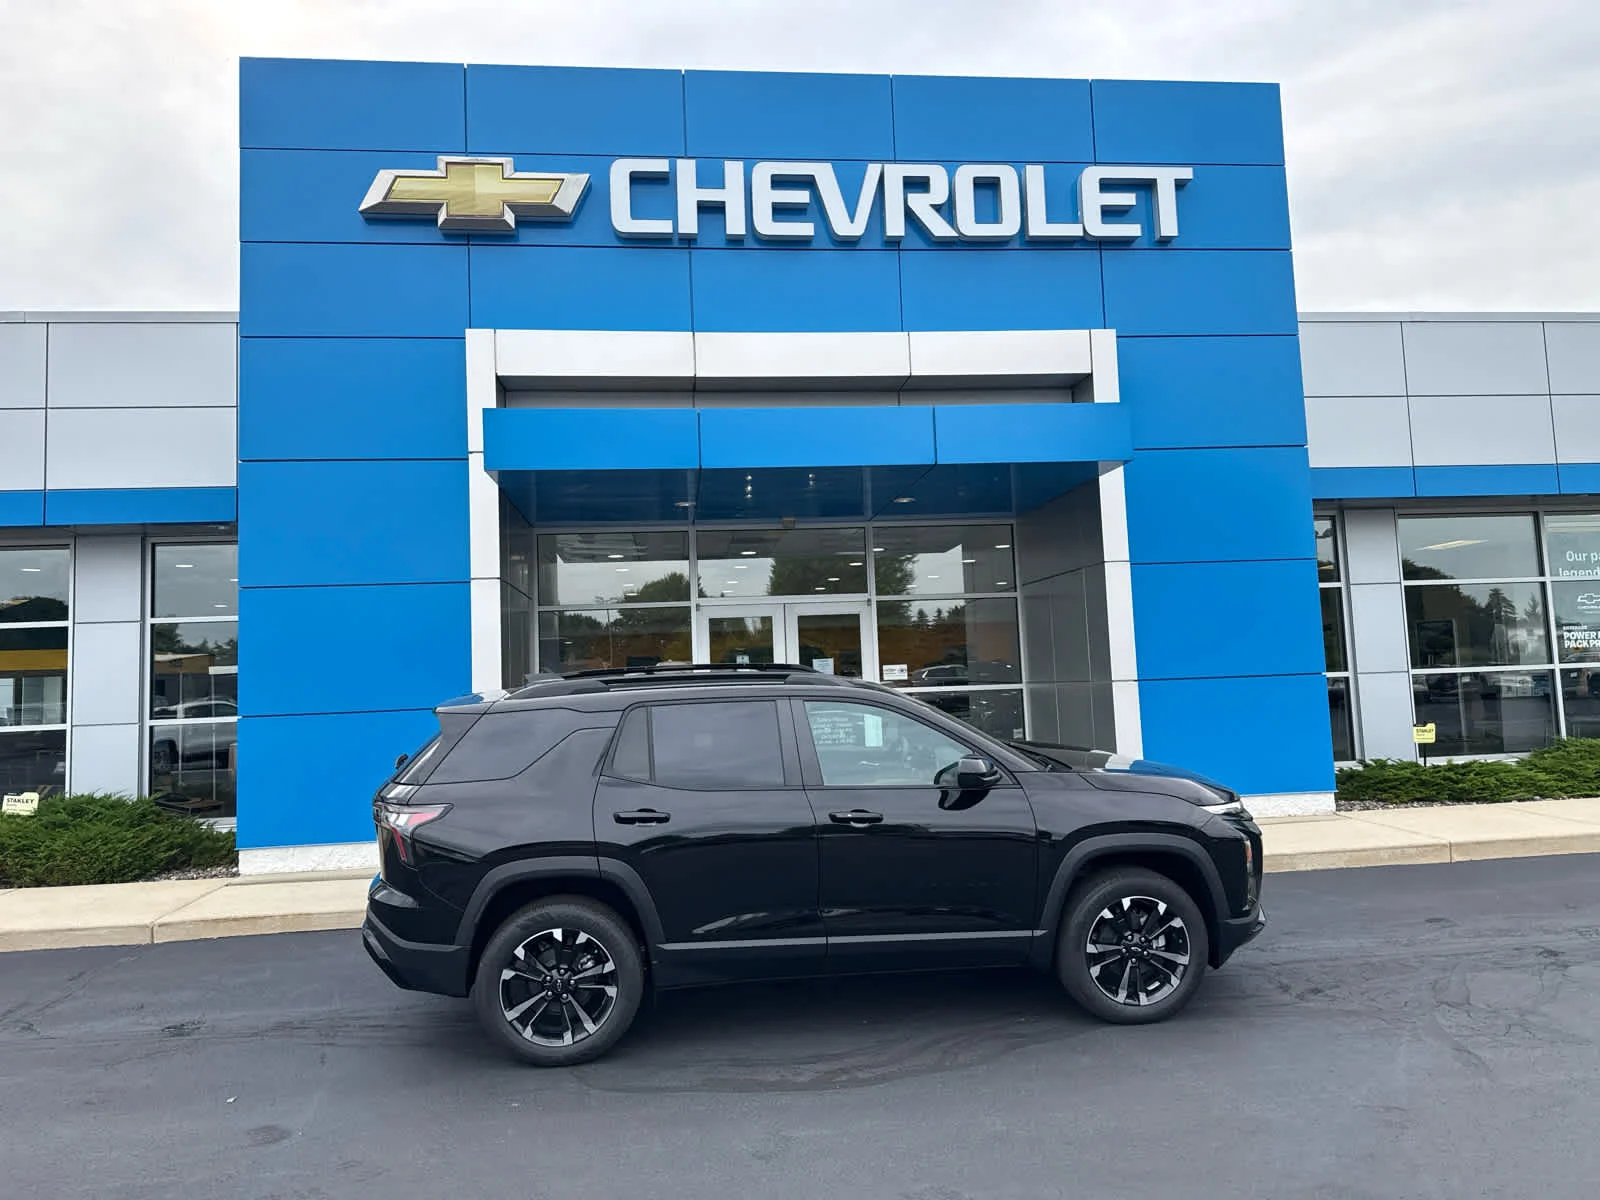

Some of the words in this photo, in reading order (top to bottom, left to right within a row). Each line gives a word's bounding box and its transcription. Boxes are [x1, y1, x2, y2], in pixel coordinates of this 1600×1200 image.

[609, 158, 1194, 243] CHEVROLET
[1566, 550, 1588, 561] Our
[1590, 551, 1600, 564] p
[1563, 631, 1596, 640] POWER
[1564, 640, 1588, 648] PACK
